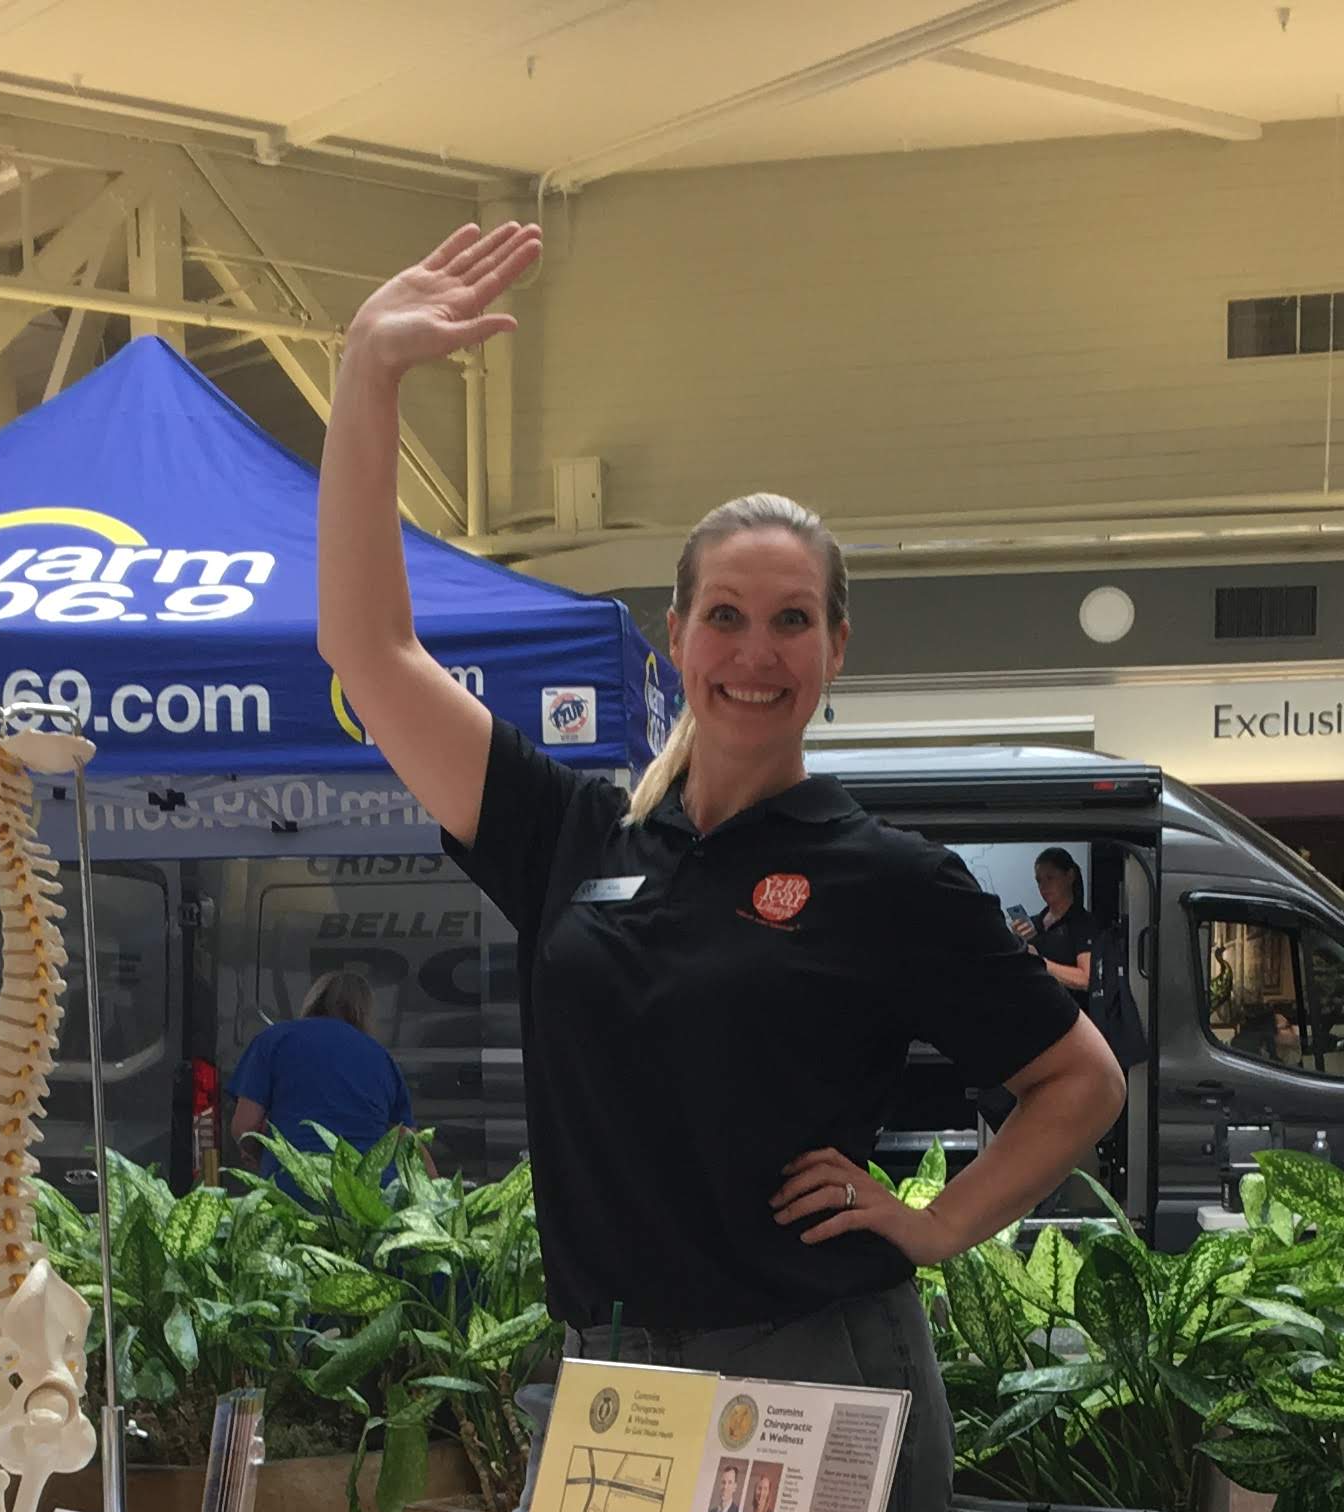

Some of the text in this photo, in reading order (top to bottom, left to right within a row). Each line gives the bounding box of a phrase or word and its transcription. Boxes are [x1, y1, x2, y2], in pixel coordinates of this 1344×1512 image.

[307, 856, 443, 876] CRISIS
[767, 1405, 804, 1417] Cummins
[763, 1418, 812, 1433] Chiropractic
[759, 1432, 804, 1445] & Wellness
